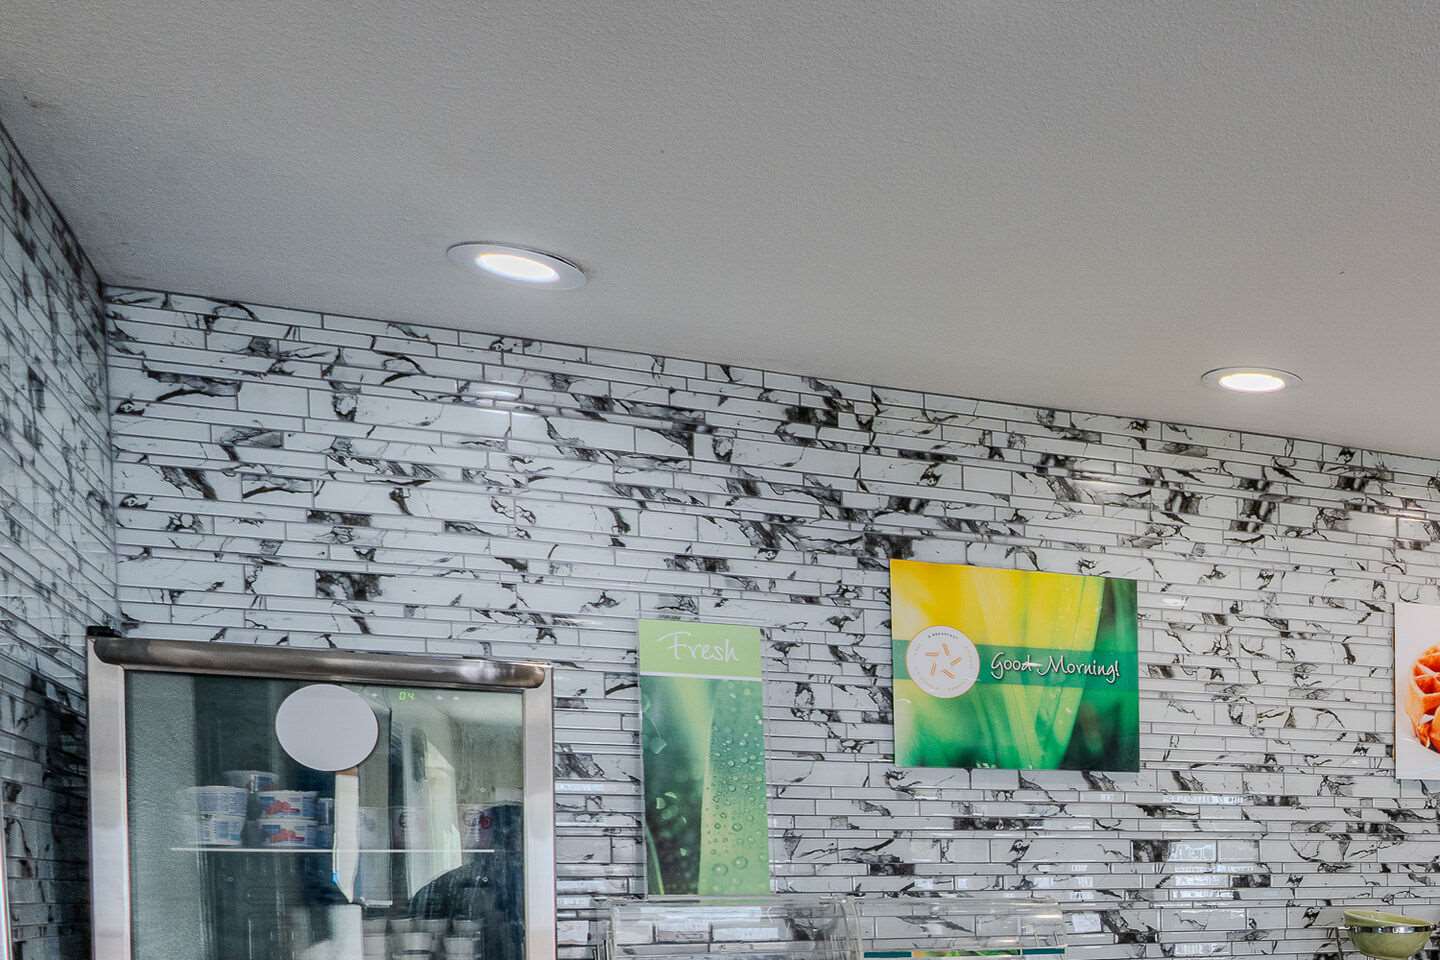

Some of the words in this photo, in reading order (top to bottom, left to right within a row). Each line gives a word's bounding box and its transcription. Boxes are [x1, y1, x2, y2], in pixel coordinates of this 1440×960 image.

[657, 631, 740, 662] Fresh
[990, 651, 1042, 680] Good
[1037, 655, 1120, 684] Morning!
